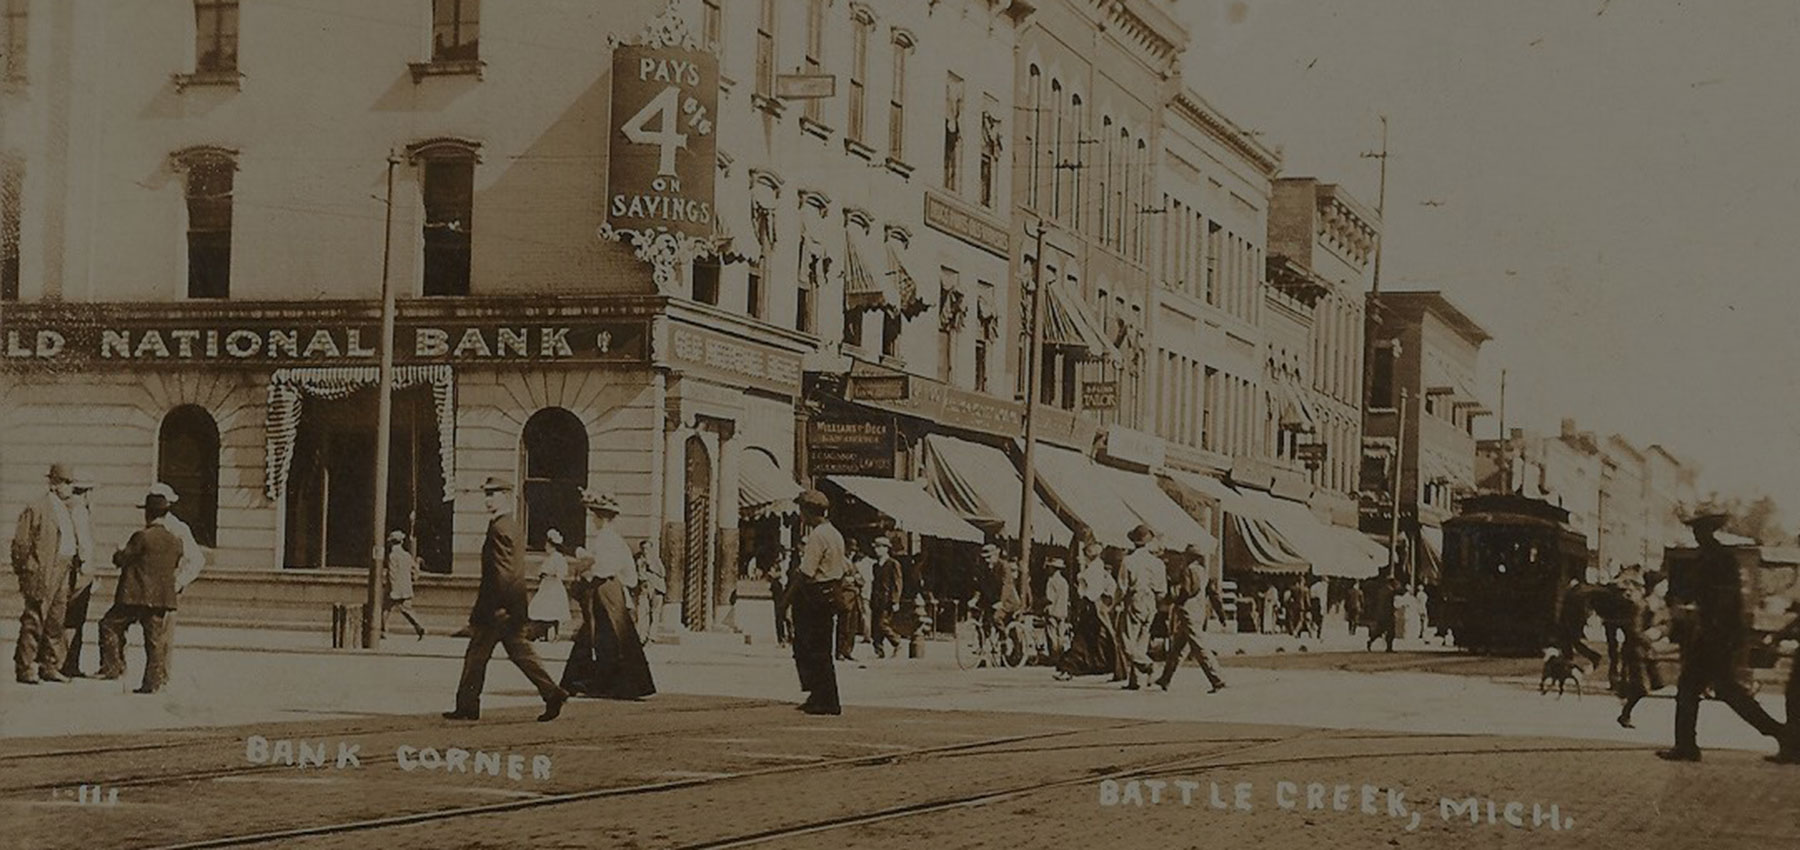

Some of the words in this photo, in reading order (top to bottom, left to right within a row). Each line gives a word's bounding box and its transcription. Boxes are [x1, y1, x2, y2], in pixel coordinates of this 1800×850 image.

[640, 58, 699, 87] PAYS
[651, 178, 681, 193] ON
[612, 194, 710, 223] SAVINGS
[101, 328, 375, 358] NATIONAL
[415, 328, 574, 357] BANK
